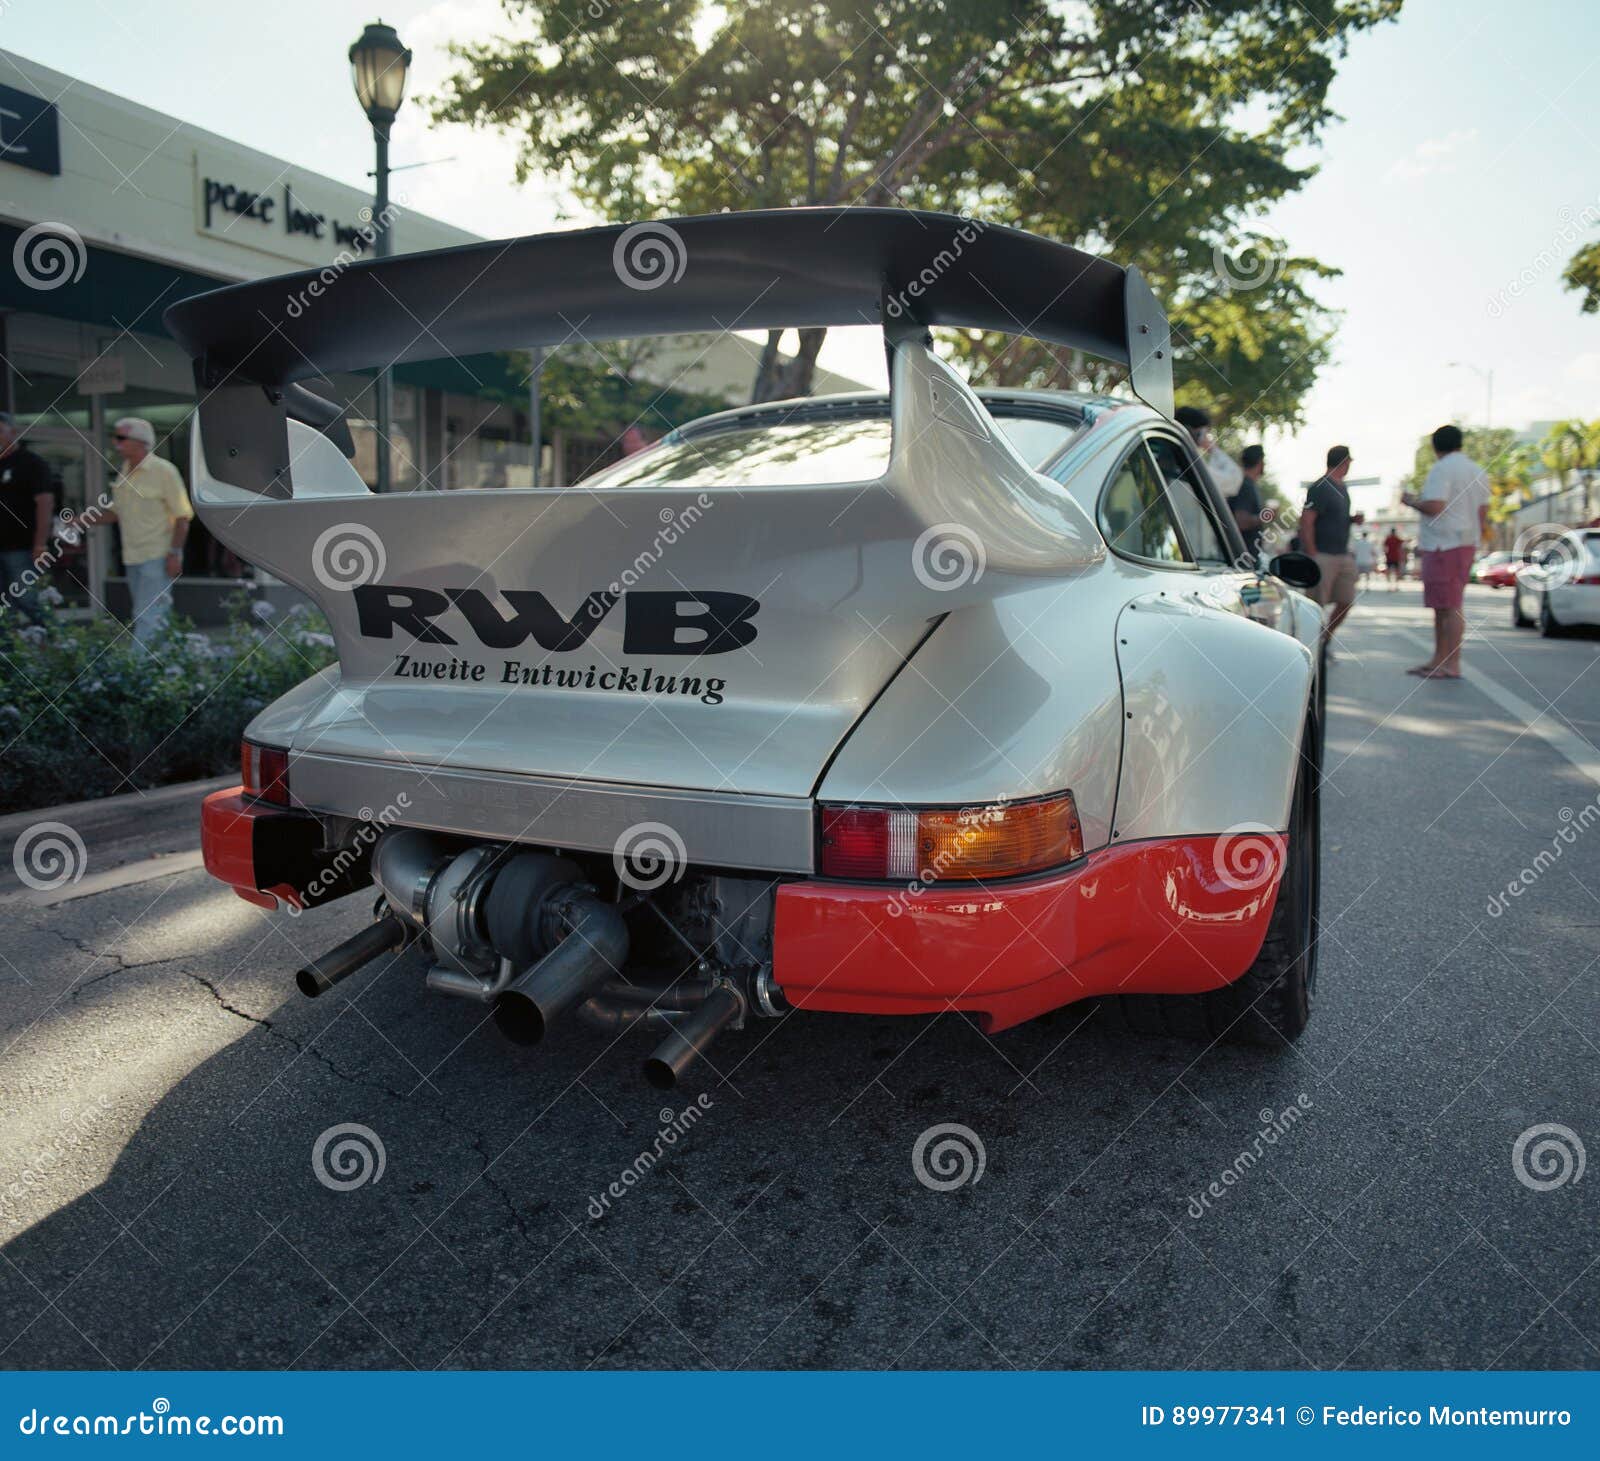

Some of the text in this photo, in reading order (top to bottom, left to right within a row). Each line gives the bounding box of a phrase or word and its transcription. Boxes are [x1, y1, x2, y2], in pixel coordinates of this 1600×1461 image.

[204, 177, 274, 228] peace
[350, 583, 760, 656] RWB
[393, 654, 727, 705] Zweite Entwicklung
